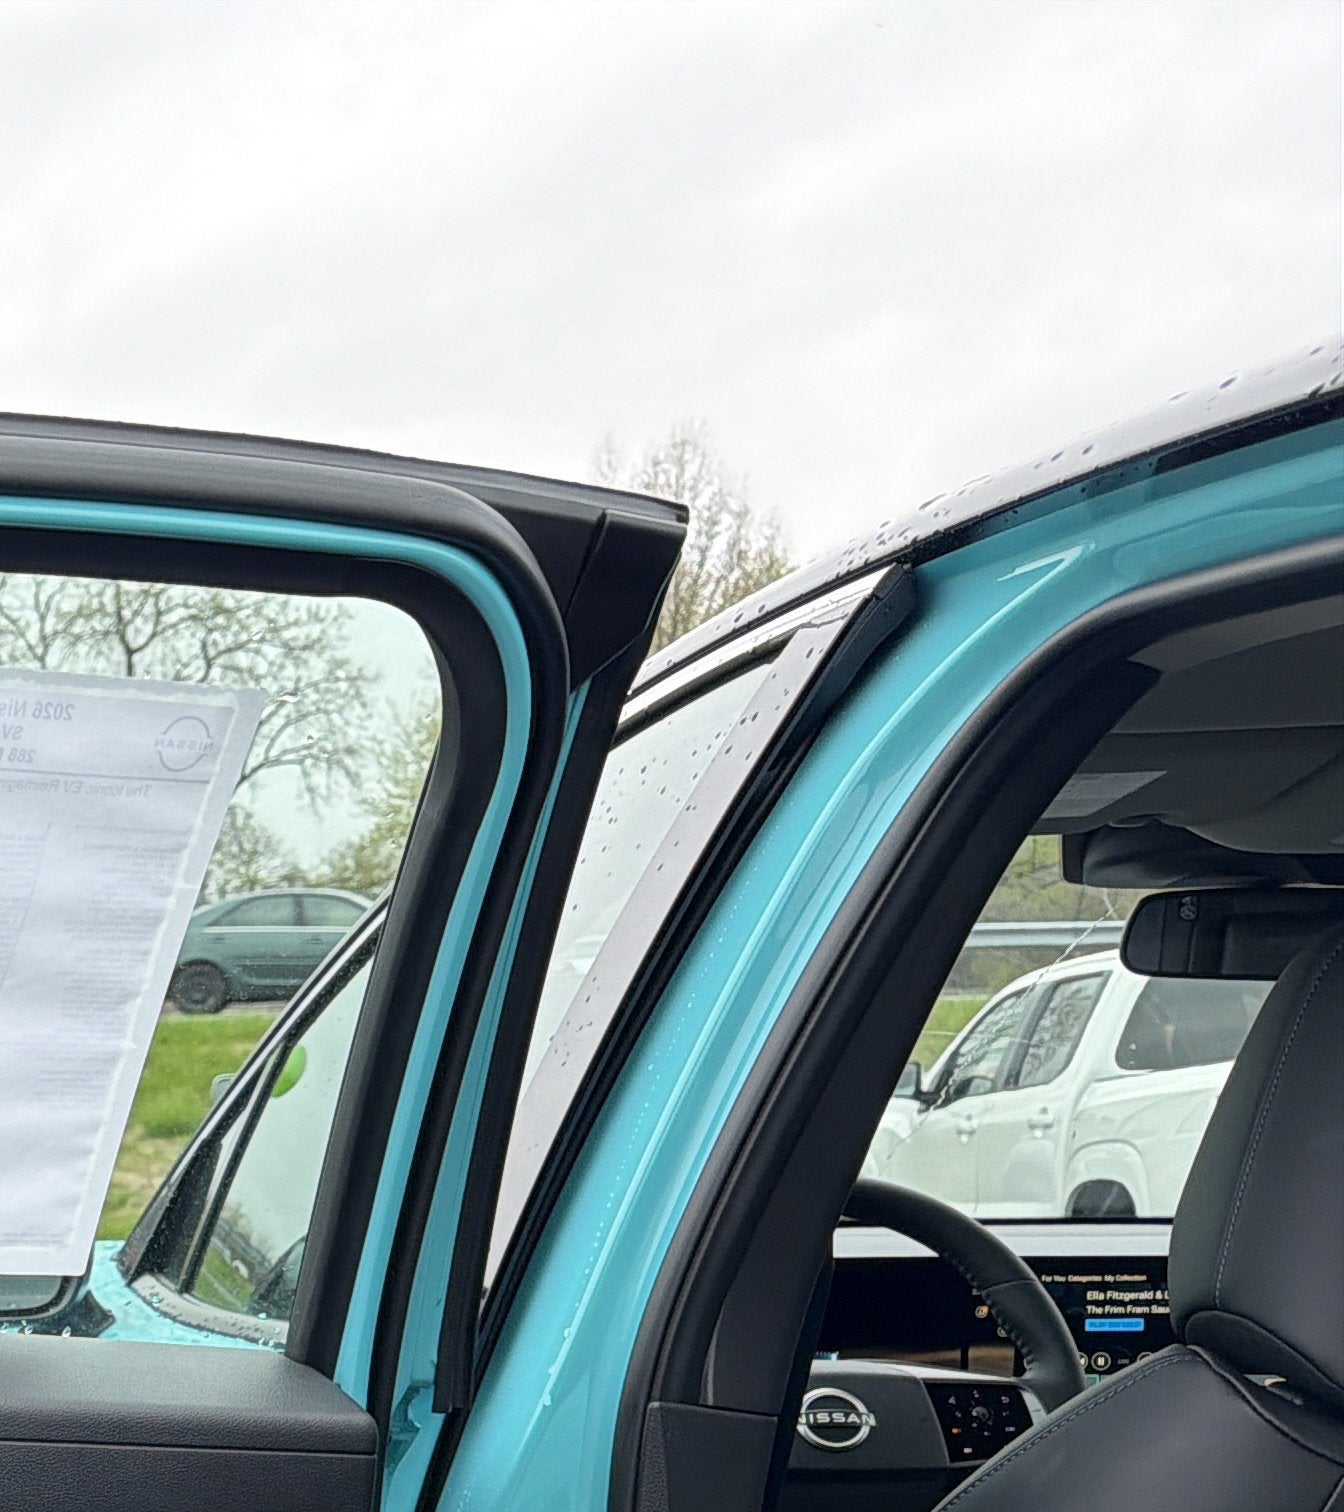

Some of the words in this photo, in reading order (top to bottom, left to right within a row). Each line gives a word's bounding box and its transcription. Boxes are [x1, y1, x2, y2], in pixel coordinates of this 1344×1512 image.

[1086, 1290, 1105, 1300] Ella
[1106, 1290, 1154, 1302] Fitzgerald
[1086, 1305, 1103, 1314] The
[1104, 1305, 1126, 1314] Frim
[1127, 1305, 1150, 1314] Fram
